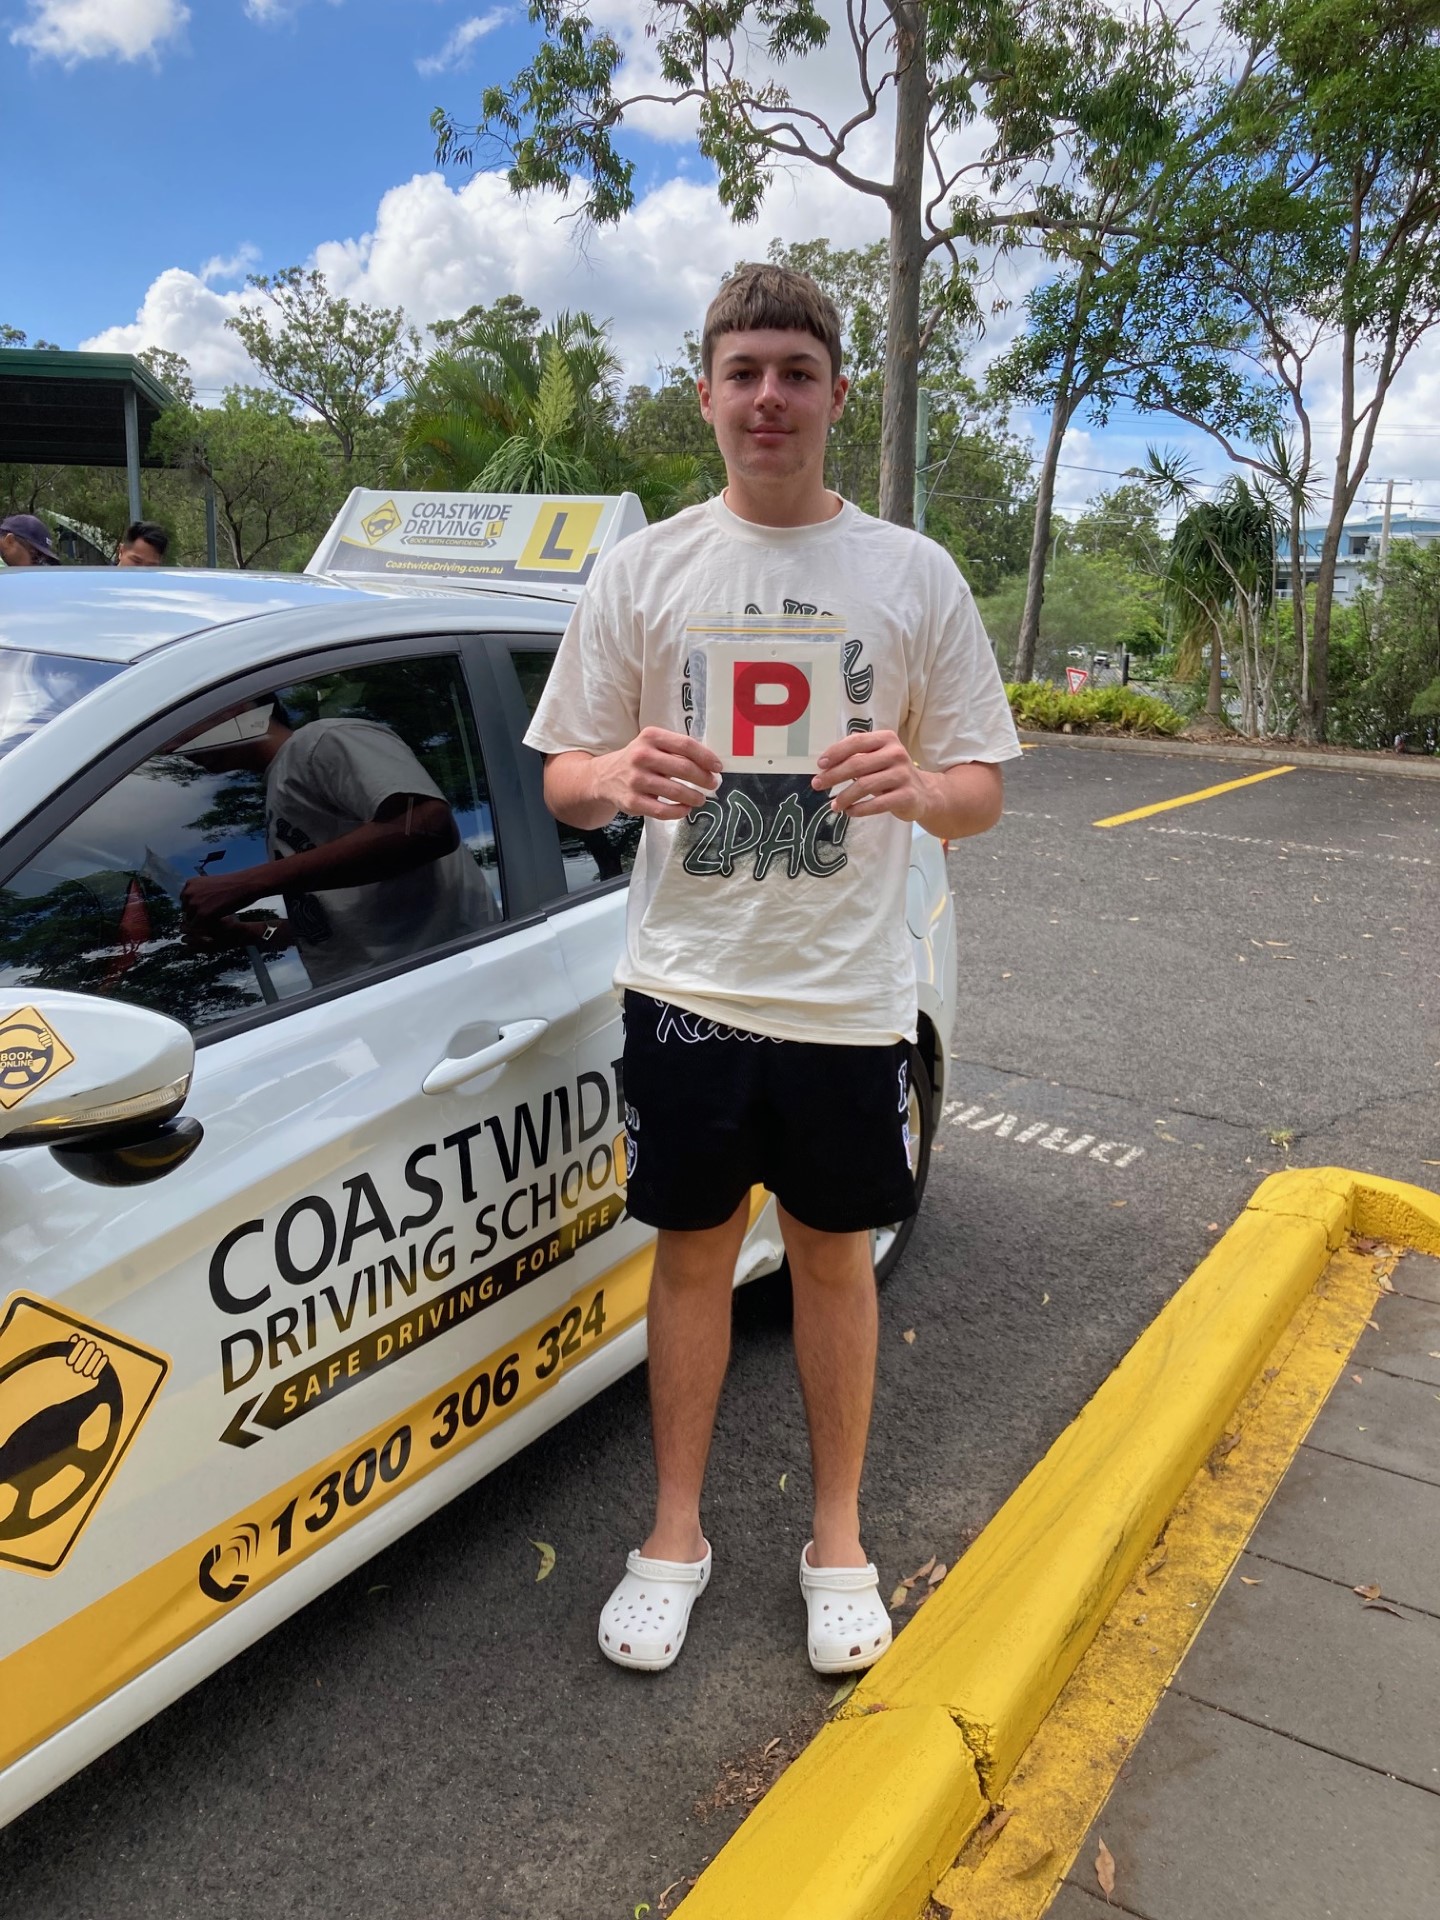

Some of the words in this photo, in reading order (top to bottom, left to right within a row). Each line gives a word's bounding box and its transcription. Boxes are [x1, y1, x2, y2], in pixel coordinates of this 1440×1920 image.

[403, 519, 482, 536] DRIVING
[489, 523, 498, 536] L
[412, 502, 512, 520] COASTWIDE
[538, 512, 574, 560] L
[385, 560, 504, 574] CoastwideDriving.com.au
[682, 789, 850, 881] 2PAC
[0, 1051, 33, 1061] BOOK
[0, 1060, 33, 1068] ONLINE
[220, 1226, 456, 1396] DRIVING
[282, 1354, 362, 1414] SAFE
[376, 1281, 504, 1362] DRIVING,
[515, 1242, 561, 1282] FOR
[271, 1424, 412, 1557] 1300
[429, 1353, 520, 1450] 306
[534, 1289, 606, 1380] 324
